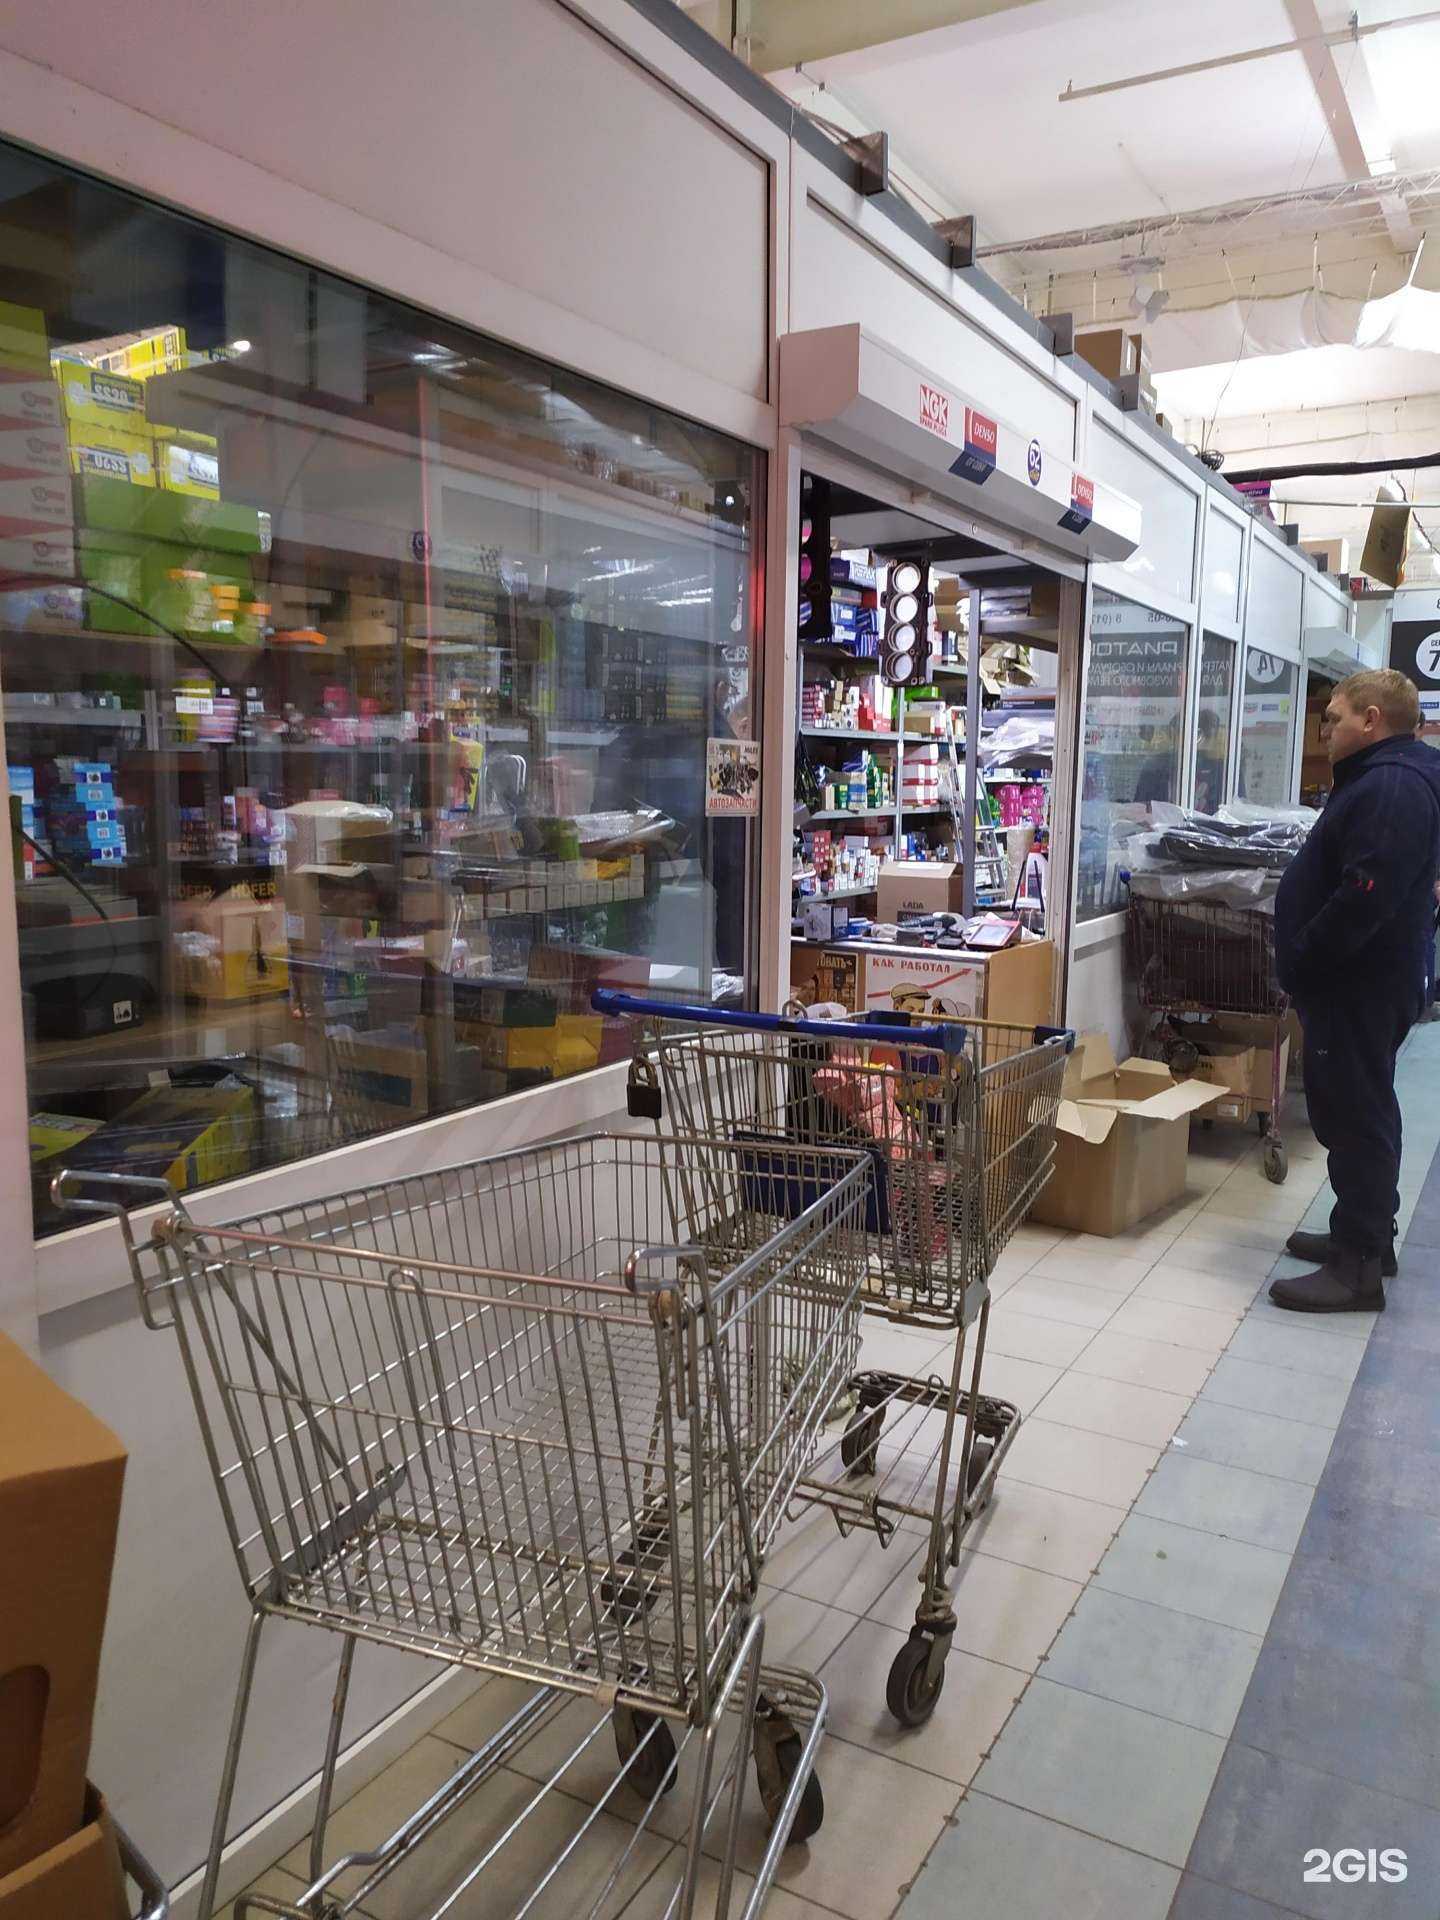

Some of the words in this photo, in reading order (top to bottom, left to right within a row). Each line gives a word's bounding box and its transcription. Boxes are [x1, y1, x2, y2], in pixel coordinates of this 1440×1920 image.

[920, 386, 947, 426] NGK
[974, 422, 995, 444] DENSO
[708, 797, 758, 810] АВТОЗАПЧАСТИ
[902, 901, 924, 910] LADA
[872, 957, 895, 969] КАК
[900, 960, 951, 974] РАБОТАЛ
